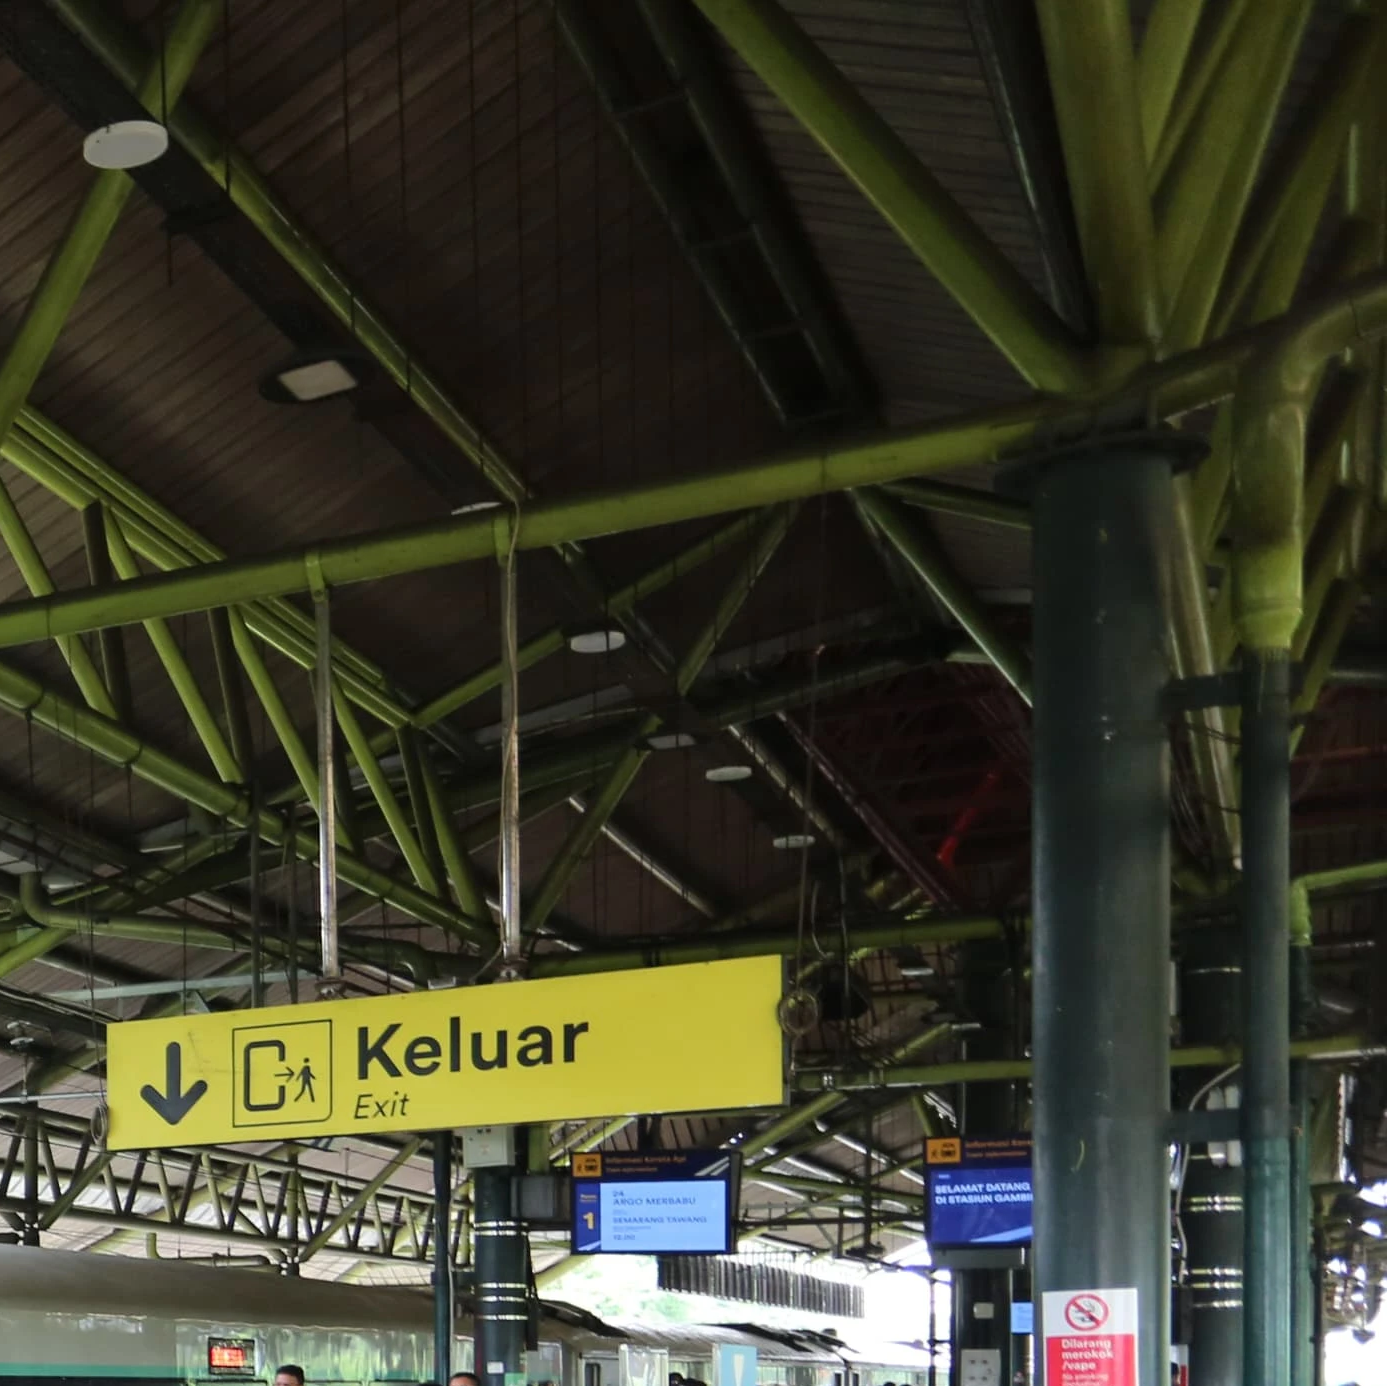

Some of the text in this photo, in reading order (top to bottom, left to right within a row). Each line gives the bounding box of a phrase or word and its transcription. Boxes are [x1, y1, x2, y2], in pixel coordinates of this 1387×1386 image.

[357, 1016, 589, 1080] Keluar
[353, 1091, 409, 1121] Exit
[935, 1181, 1030, 1194] SELAMAT DATANG
[613, 1197, 696, 1206] ARGO MERBABU
[935, 1195, 947, 1204] DI
[948, 1194, 993, 1204] STASIUN
[583, 1211, 595, 1230] 1
[1061, 1338, 1112, 1350] Dilarang
[1061, 1349, 1114, 1360] merokok
[1062, 1360, 1097, 1372] /vape
